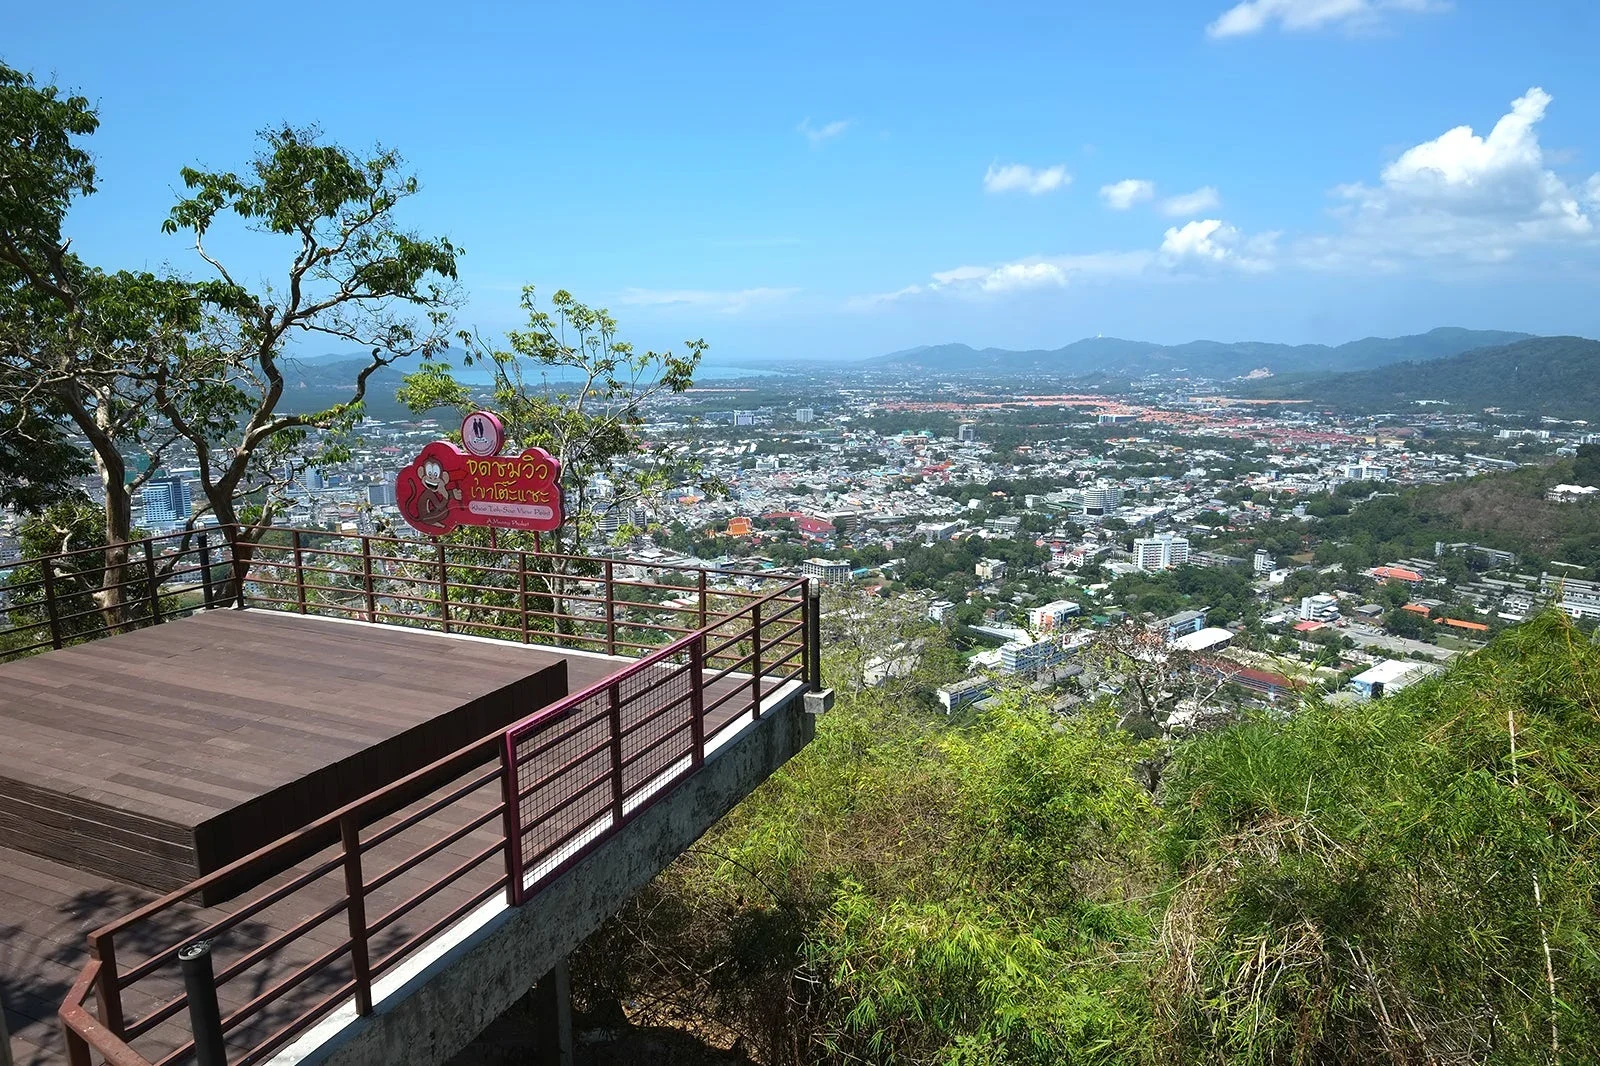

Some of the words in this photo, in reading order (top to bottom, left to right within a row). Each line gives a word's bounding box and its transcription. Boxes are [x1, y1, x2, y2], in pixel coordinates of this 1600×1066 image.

[466, 454, 548, 484] จุดชมวิว
[471, 480, 549, 502] เขาโต๊ะแซะ
